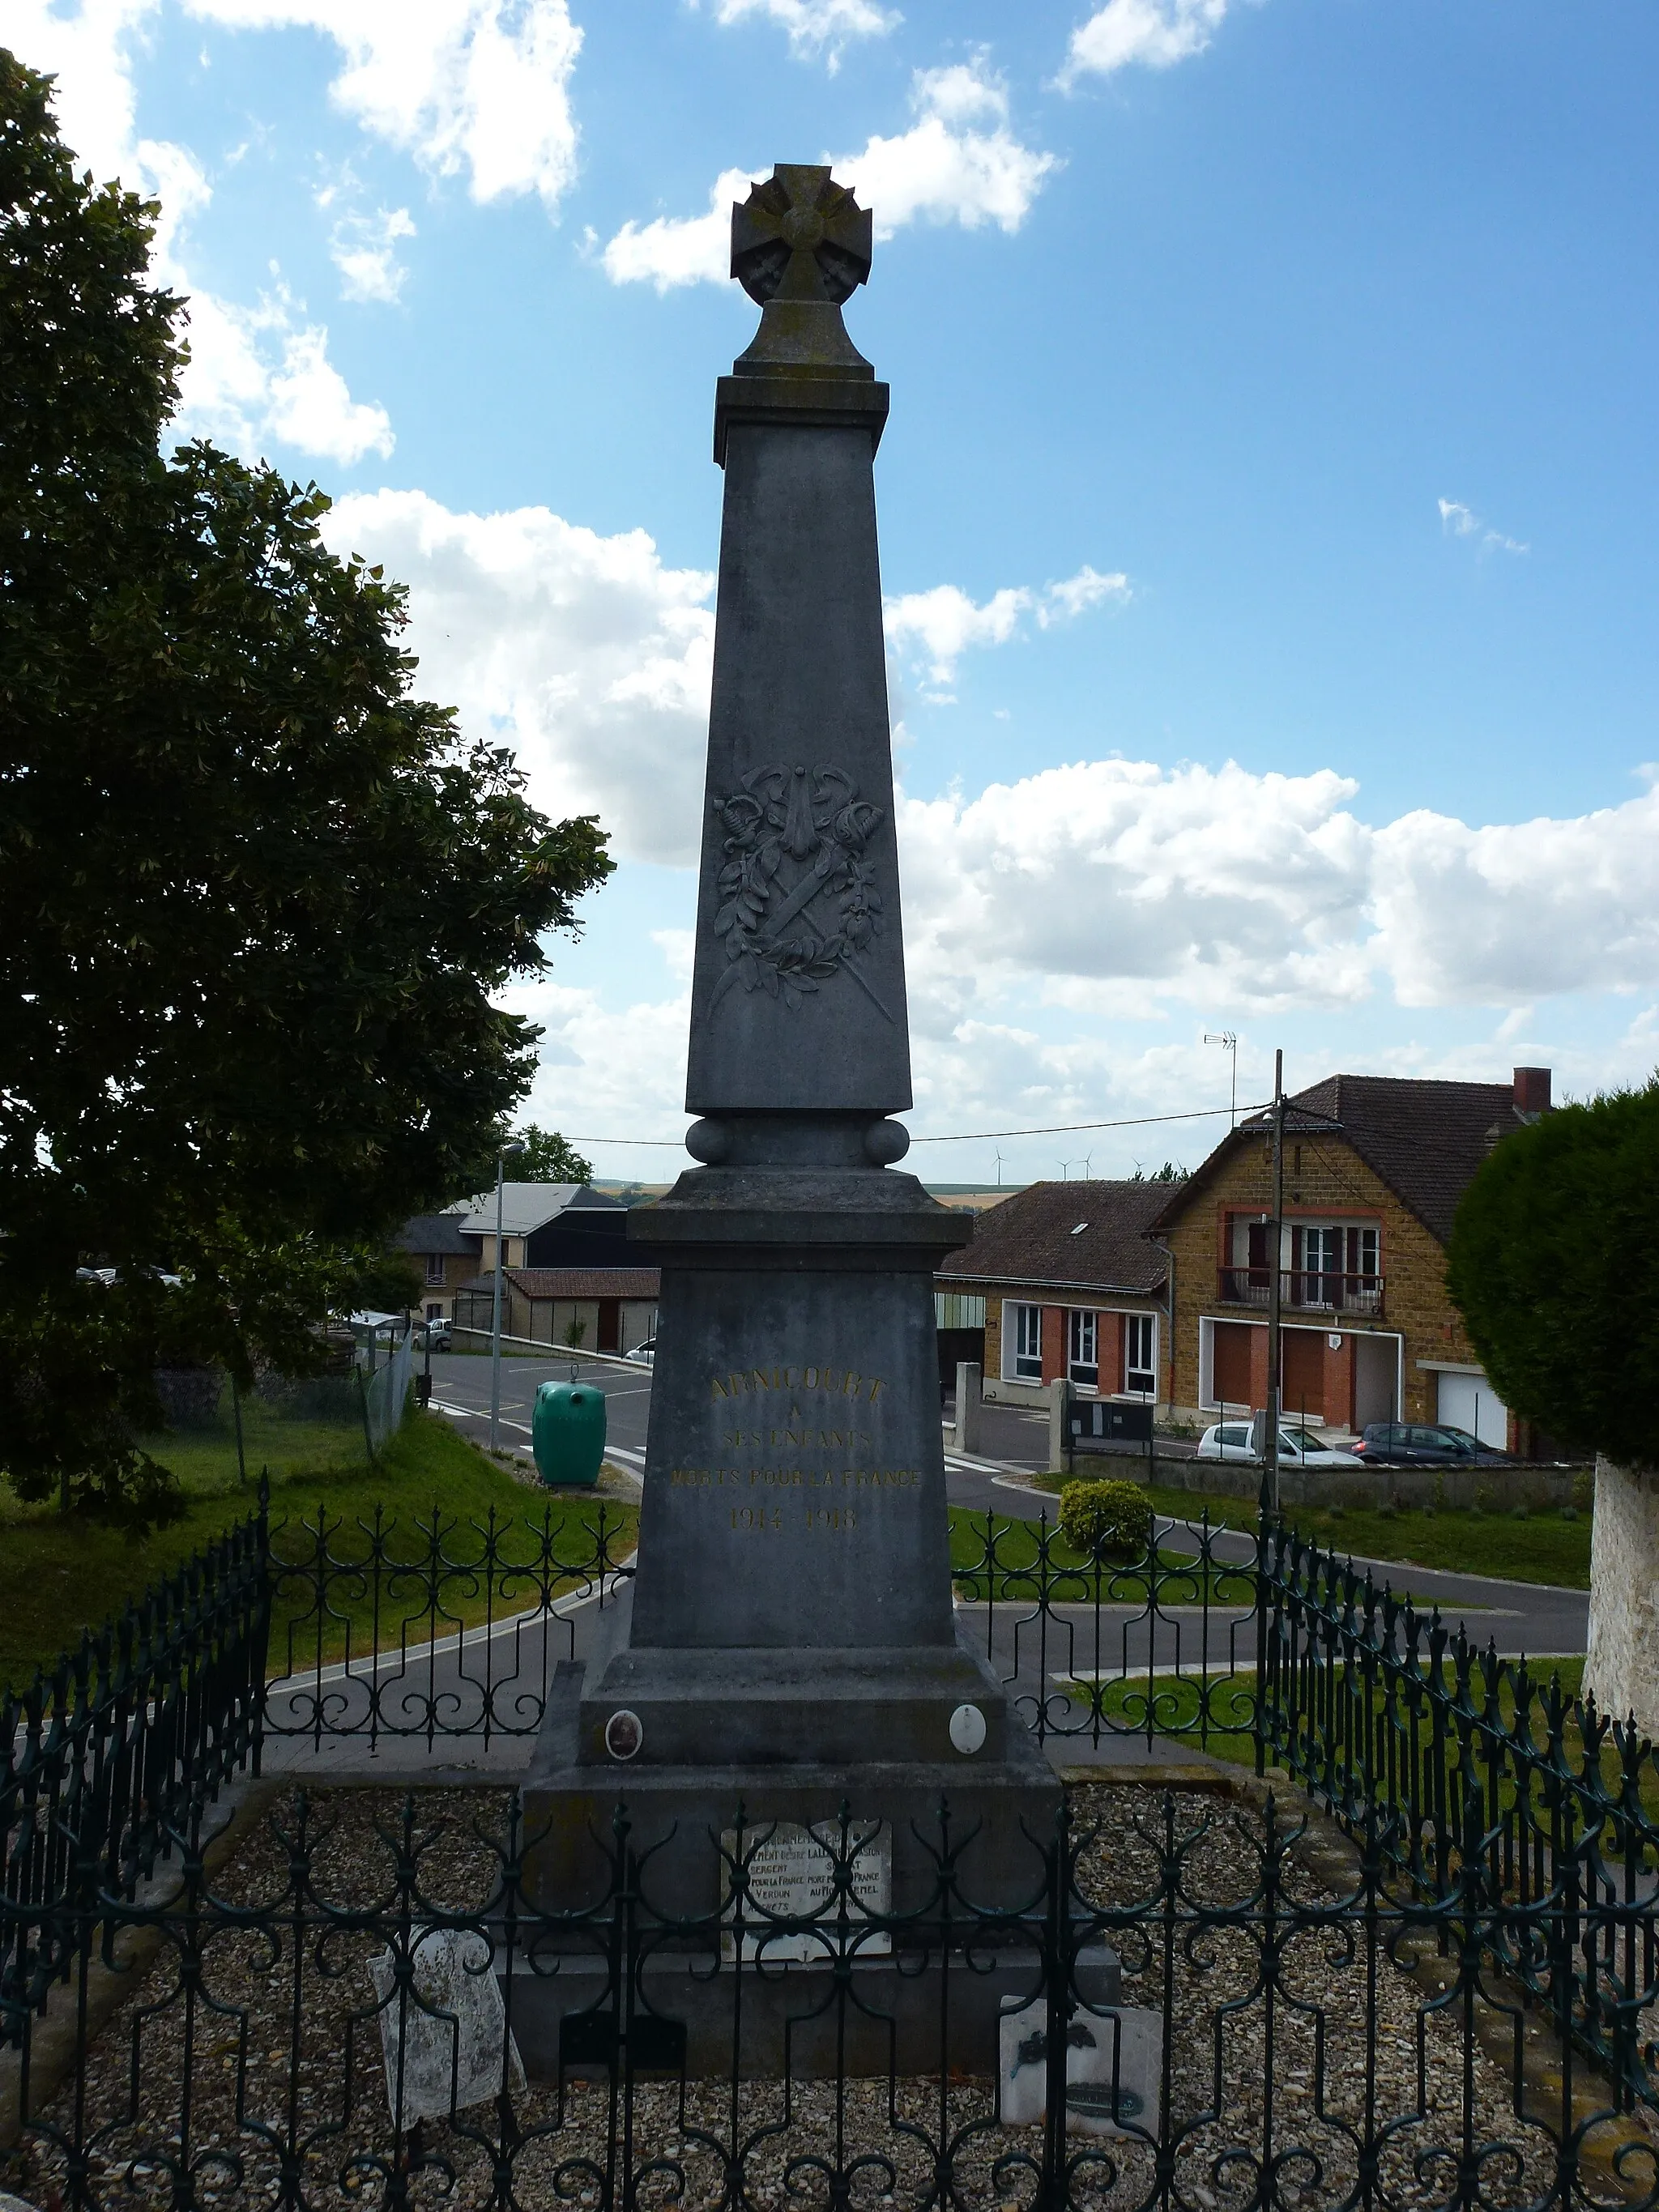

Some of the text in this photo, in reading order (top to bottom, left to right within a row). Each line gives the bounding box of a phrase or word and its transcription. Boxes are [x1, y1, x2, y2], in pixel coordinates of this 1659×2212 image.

[713, 1366, 888, 1401] ARNICOURT
[789, 1406, 800, 1422] A
[723, 1430, 871, 1447] SES ENFANTS
[672, 1468, 922, 1486] MORTS POUR LA FRANCE
[730, 1507, 783, 1530] 1914
[806, 1507, 857, 1530] 1918
[750, 1865, 787, 1875] SERGENT
[854, 1872, 880, 1882] FRANCE
[778, 1875, 804, 1886] FRANCE
[756, 1888, 791, 1899] VERDUN
